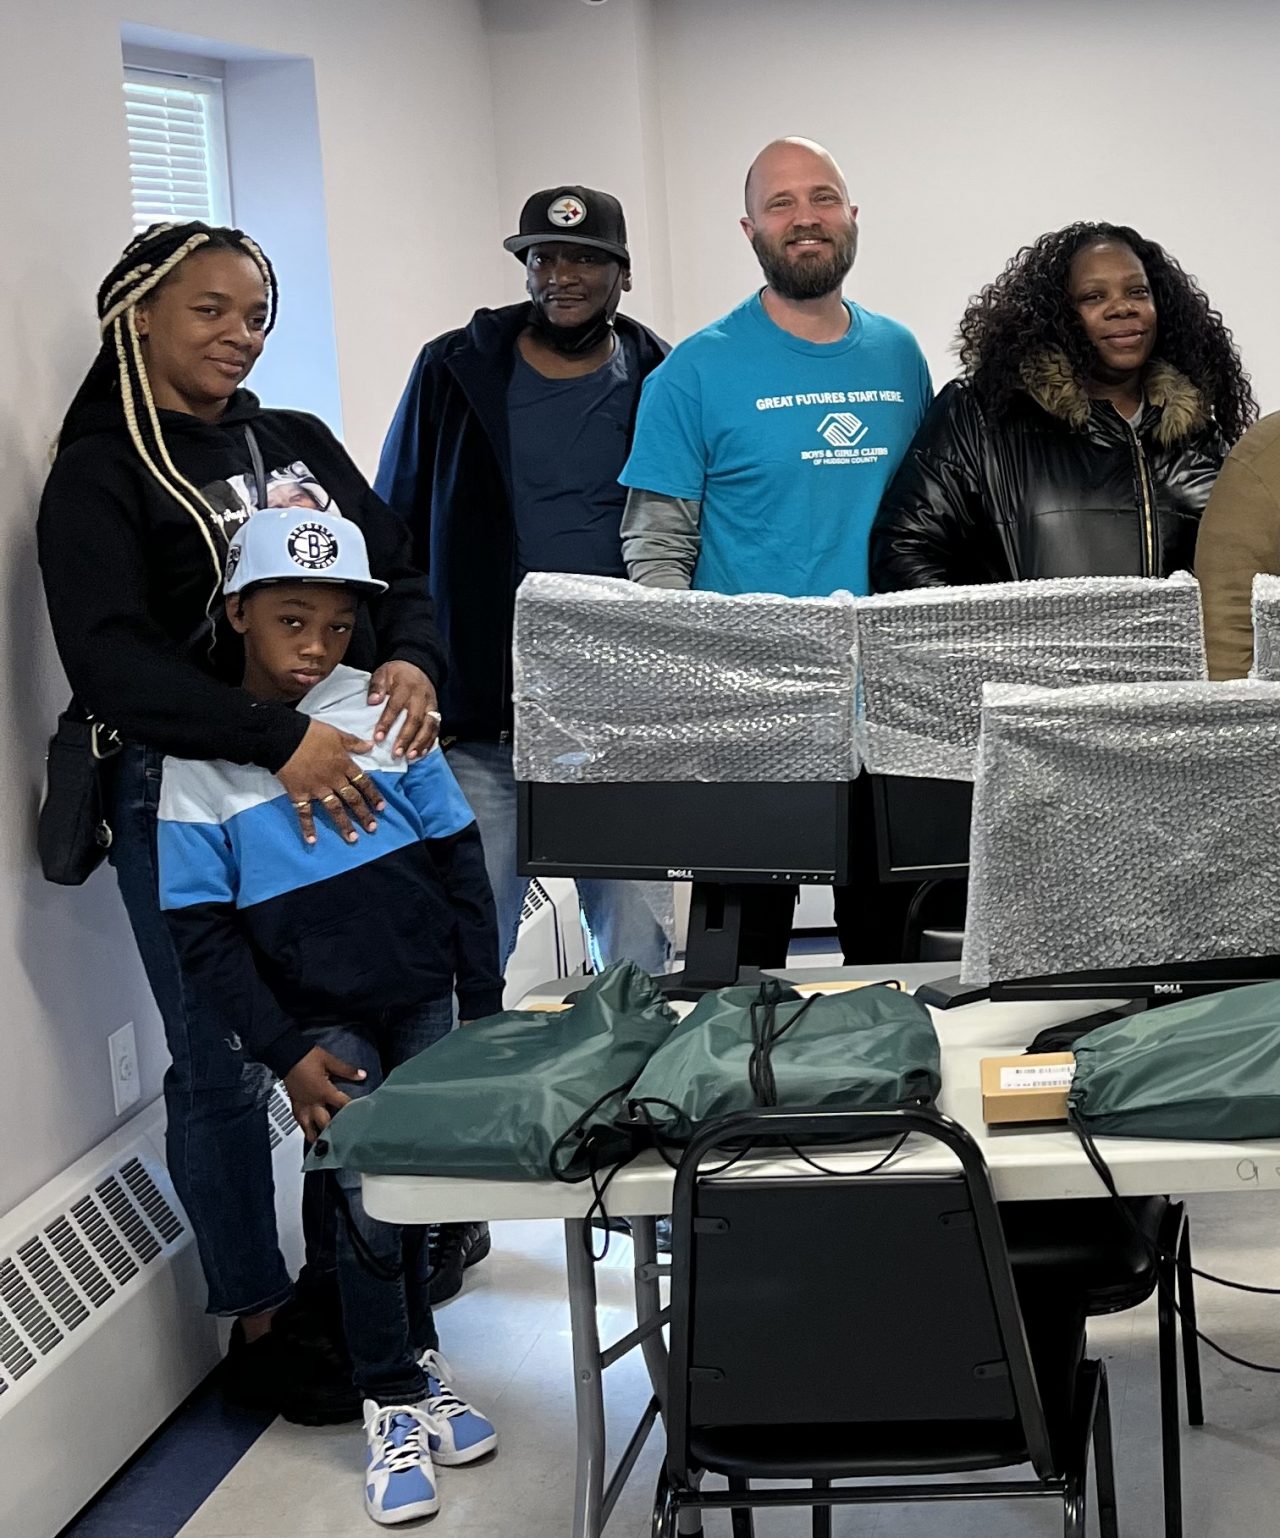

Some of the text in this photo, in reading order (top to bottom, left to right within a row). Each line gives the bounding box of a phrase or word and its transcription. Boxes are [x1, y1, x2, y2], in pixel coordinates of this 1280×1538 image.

[756, 395, 793, 411] GREAT
[795, 391, 846, 406] FUTURES
[847, 390, 878, 403] START
[800, 446, 889, 460] BOYS & GIRLS CLUBS
[813, 456, 878, 466] OF HUDSON COUNTY
[307, 533, 321, 559] B
[667, 868, 695, 879] DELL
[1154, 983, 1183, 994] DELL
